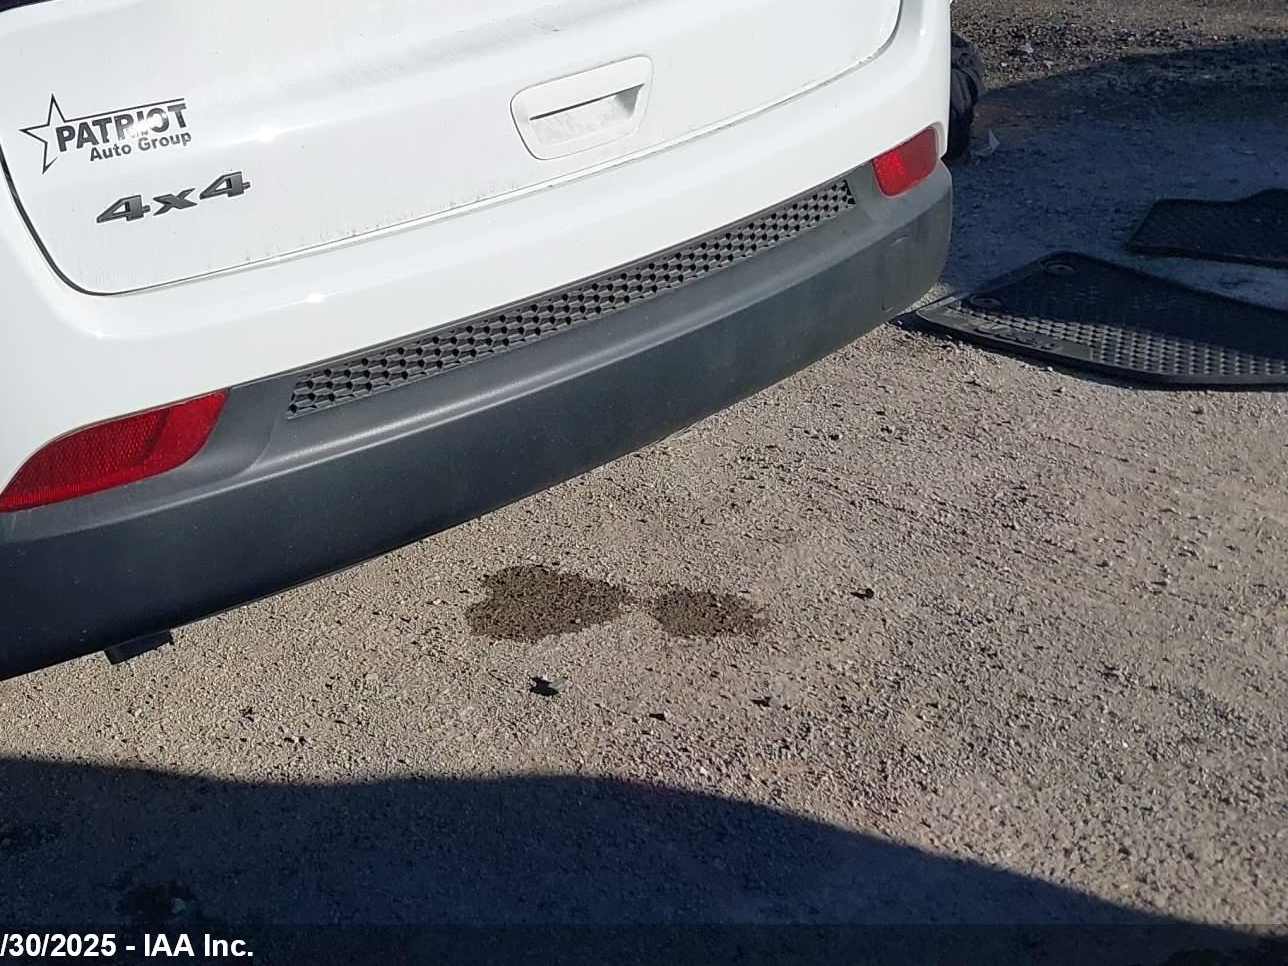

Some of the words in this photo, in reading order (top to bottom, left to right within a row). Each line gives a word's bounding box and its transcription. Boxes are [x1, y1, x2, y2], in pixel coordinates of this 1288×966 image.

[55, 102, 187, 153] PATRIOT
[90, 143, 132, 162] Auto
[137, 132, 192, 152] Group
[96, 171, 251, 223] 4x4
